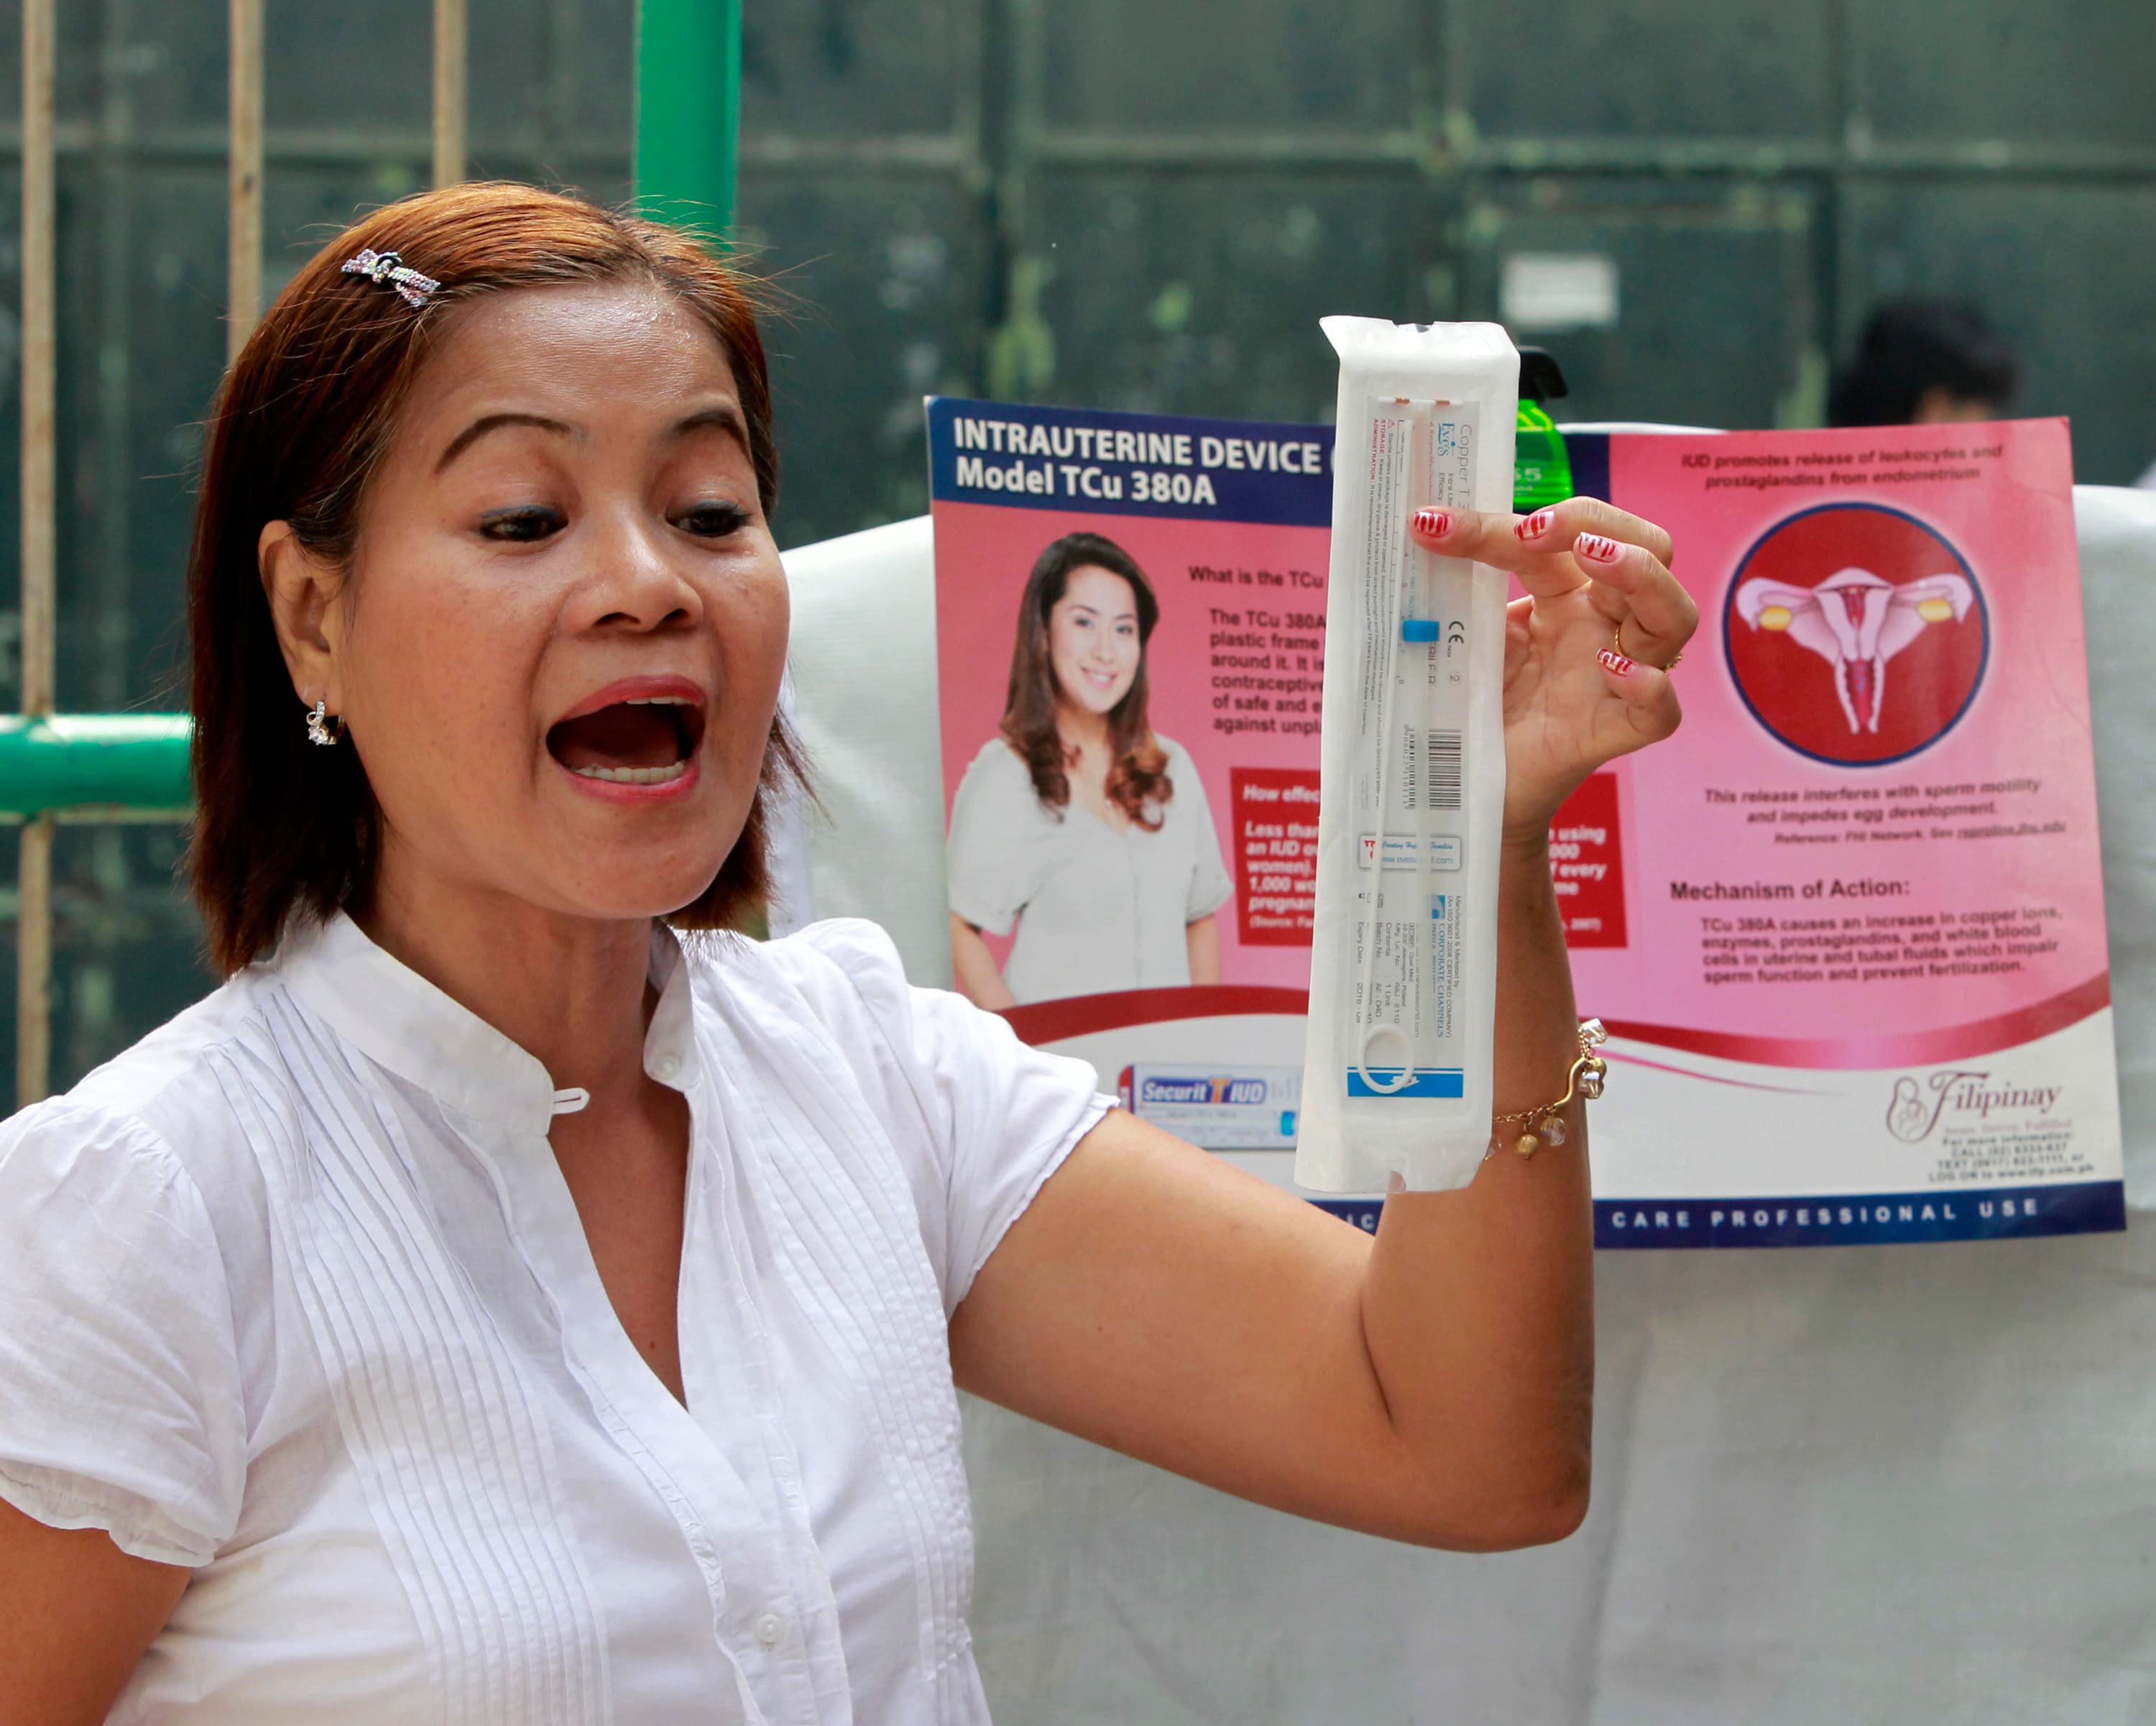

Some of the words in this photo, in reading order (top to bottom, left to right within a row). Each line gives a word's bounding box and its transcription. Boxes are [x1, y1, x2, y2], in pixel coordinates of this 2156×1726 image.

[954, 417, 1192, 466] INTRAUTERINE
[1200, 436, 1322, 474] DEVICE
[1457, 424, 1473, 483] Copper
[1682, 454, 1710, 468] IUD
[1715, 454, 1789, 469] promotes
[1795, 452, 1853, 466] release
[1858, 450, 1874, 464] of
[1879, 446, 1966, 464] leukocytes
[1973, 444, 2002, 458] and
[956, 456, 1054, 495] Model
[1060, 465, 1123, 499] TCu
[1131, 472, 1217, 505] 380A
[1705, 473, 1825, 491] prostaglandins
[1830, 472, 1867, 484] from
[1873, 468, 1979, 483] endometrium
[1459, 488, 1470, 497] T
[1189, 566, 1233, 584] What
[1238, 569, 1252, 584] is
[1258, 570, 1284, 587] the
[1289, 571, 1323, 588] TCu
[1210, 608, 1240, 625] The
[1247, 611, 1280, 628] TCu
[1286, 613, 1326, 630] 380A
[1210, 632, 1266, 650] plastic
[1271, 633, 1319, 650] frame
[1211, 654, 1270, 669] around
[1296, 656, 1307, 671] It
[1212, 694, 1229, 710] of
[1235, 695, 1269, 712] safe
[1276, 698, 1306, 712] and
[1214, 717, 1276, 734] against
[1243, 784, 1279, 802] How
[1705, 789, 1736, 804] This
[1741, 788, 1798, 802] release
[1803, 786, 1879, 802] interferes
[1885, 785, 1919, 798] with
[1926, 783, 1975, 800] sperm
[1981, 778, 2041, 794] motility
[1747, 809, 1777, 823] and
[1781, 808, 1848, 825] impedes
[1853, 809, 1883, 823] egg
[1245, 820, 1283, 837] Less
[1558, 825, 1606, 845] using
[1246, 843, 1267, 855] an
[1270, 840, 1300, 856] IUD
[1560, 864, 1607, 881] every
[1670, 881, 1794, 900] Mechanism
[1802, 878, 1823, 898] of
[1830, 877, 1909, 897] Action:
[1249, 897, 1314, 914] pregnan
[1700, 918, 1732, 932] TCu
[1738, 917, 1775, 931] 380A
[1780, 918, 1836, 931] causes
[1842, 918, 1861, 929] an
[1866, 914, 1934, 927] increase
[1940, 912, 1955, 924] in
[1960, 910, 2017, 925] copper
[1911, 931, 1940, 943] and
[1947, 928, 1989, 941] white
[1994, 924, 2041, 938] blood
[1703, 952, 1738, 965] cells
[1745, 952, 1758, 965] in
[1763, 951, 1818, 965] uterine
[1824, 950, 1853, 963] and
[1858, 948, 1898, 962] tubal
[1903, 947, 1948, 960] fluids
[1954, 944, 2001, 958] which
[2007, 940, 2058, 955] impair
[1704, 970, 1753, 986] sperm
[1758, 968, 1823, 982] function
[1829, 968, 1858, 981] and
[1864, 965, 1923, 982] prevent
[1230, 1080, 1266, 1103] IUD
[1928, 1070, 2062, 1121] Filipinay
[1612, 1211, 1690, 1228] CARE
[1710, 1204, 1957, 1227] PROFESSIONAL
[1979, 1198, 2037, 1218] USE
